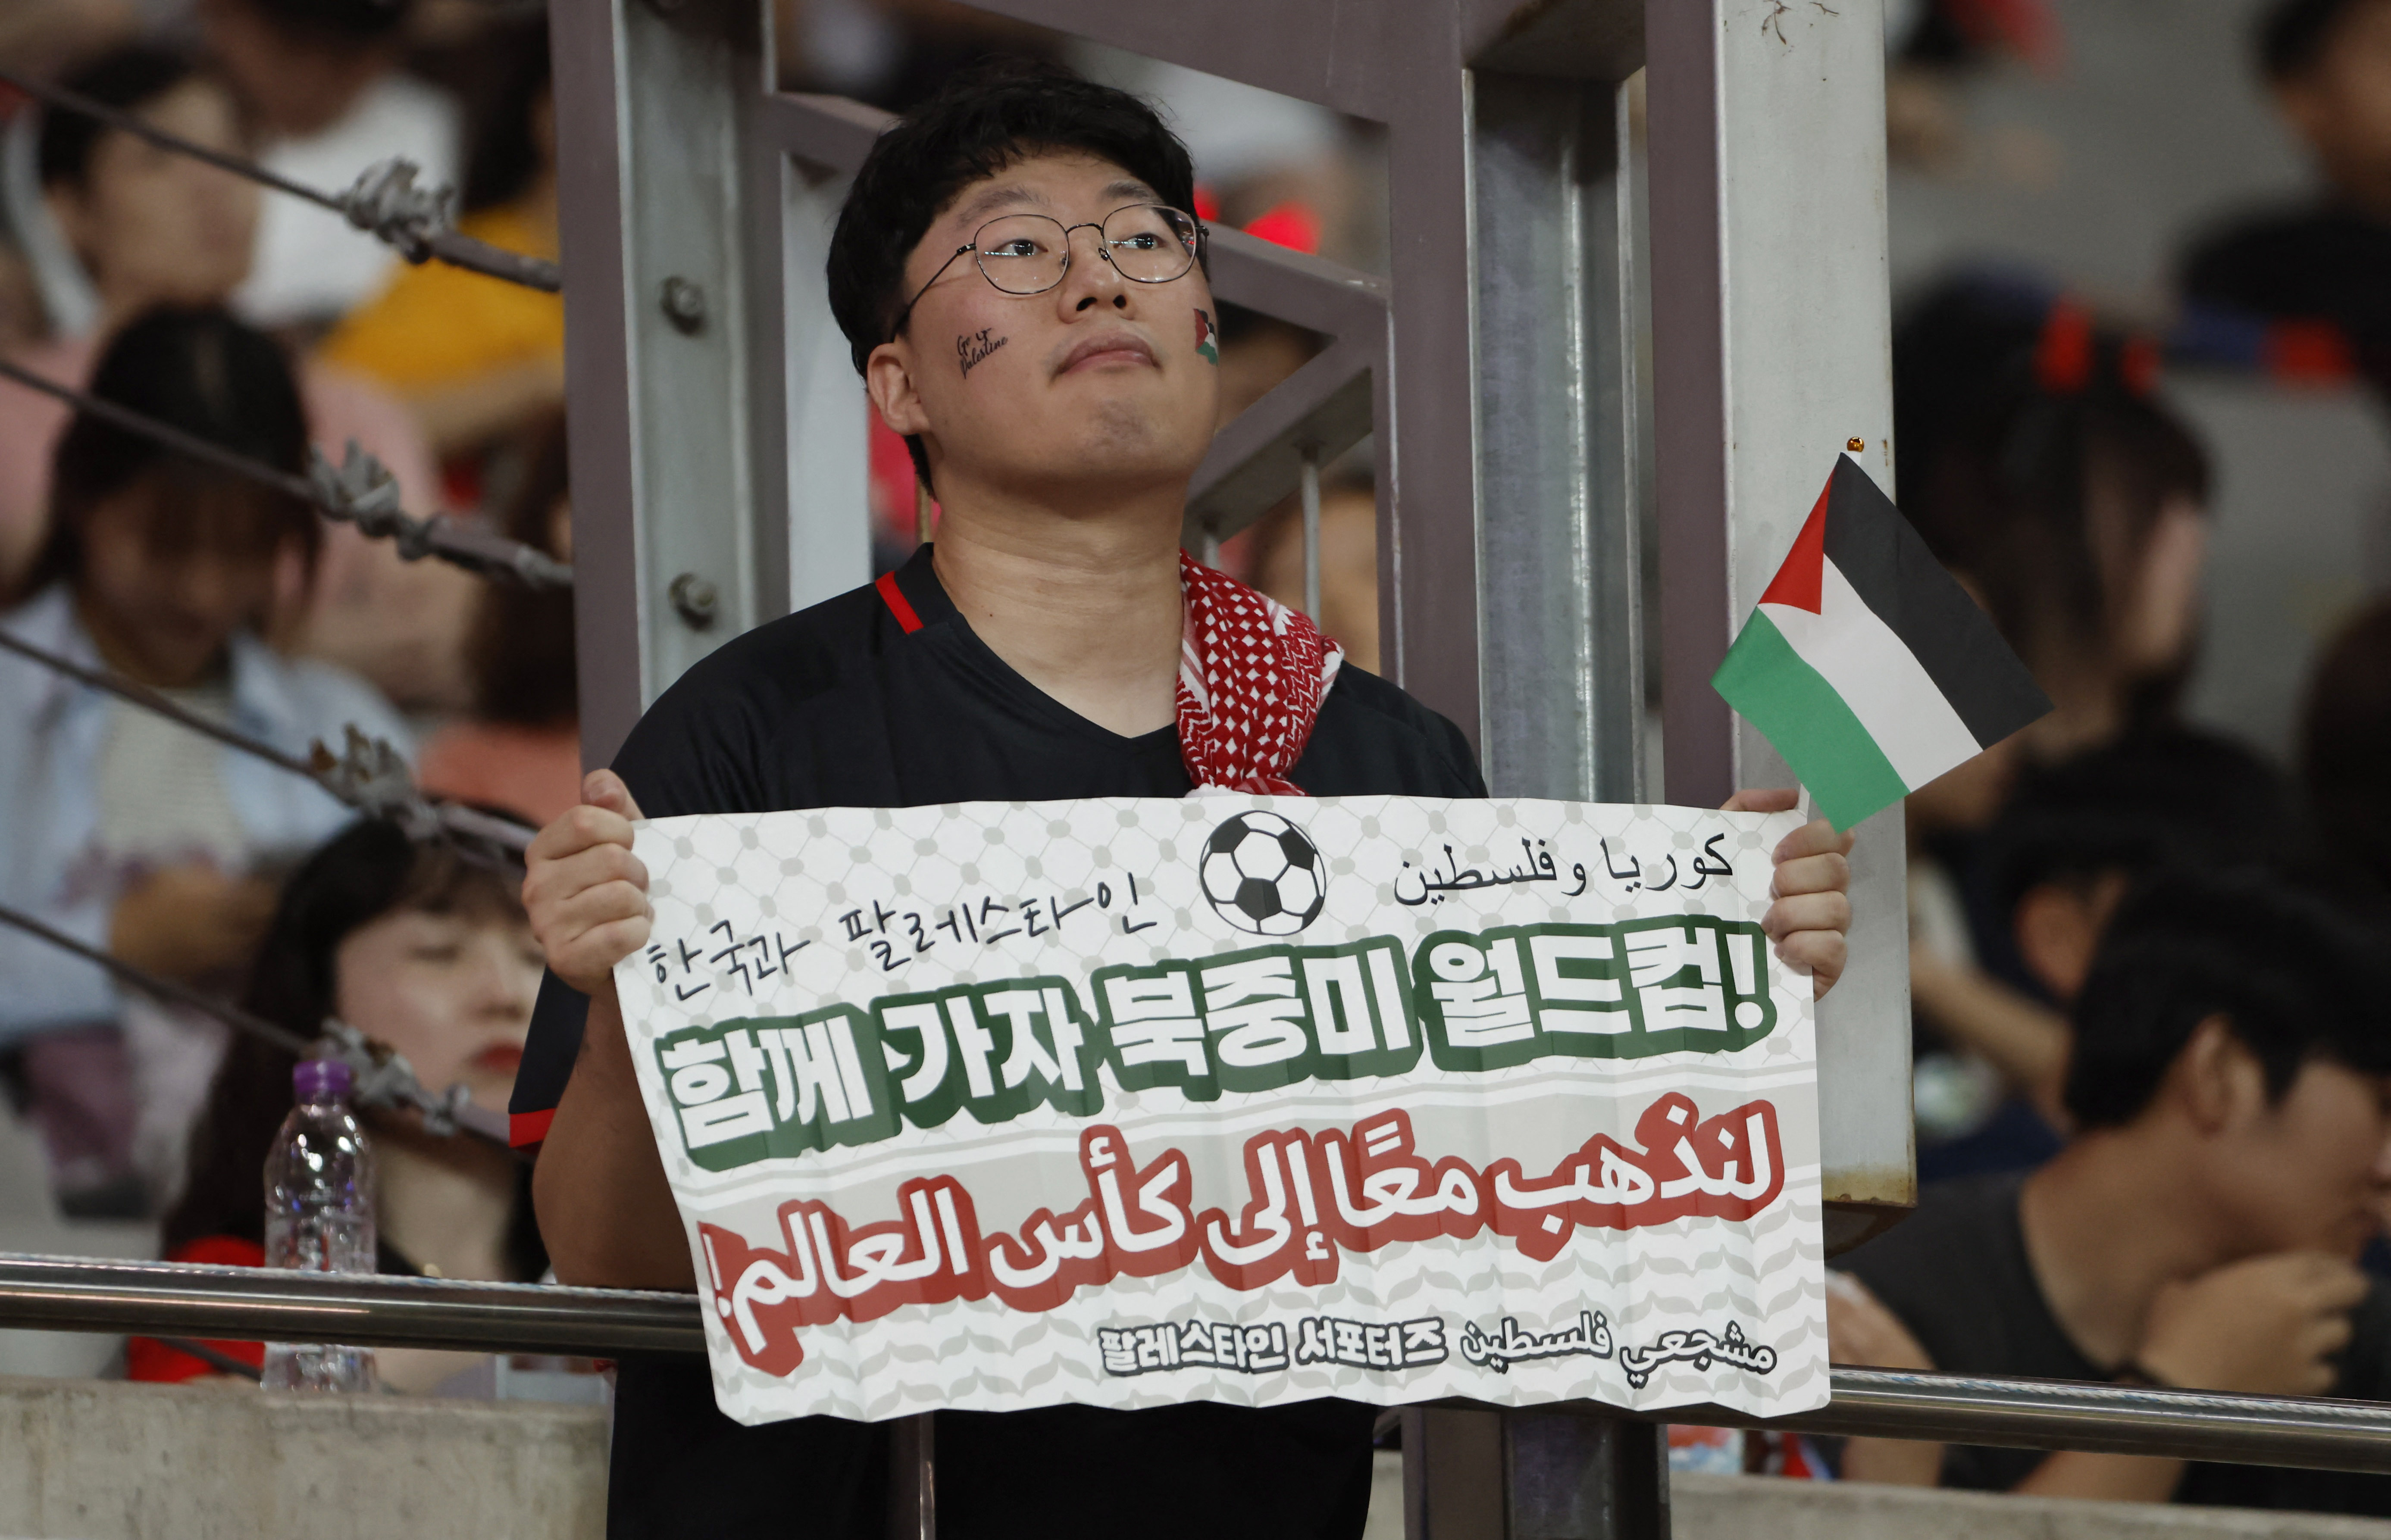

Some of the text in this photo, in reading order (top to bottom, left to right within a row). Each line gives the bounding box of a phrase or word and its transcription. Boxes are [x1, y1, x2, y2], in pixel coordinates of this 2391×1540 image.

[1599, 832, 1734, 893] كوريا
[646, 871, 1157, 1002] 한국과 팔레스타인
[660, 924, 1767, 1152] 함께 가자 북중미 월드컵!
[986, 1133, 1189, 1291] كأس
[1204, 1138, 1329, 1267] إلى
[1493, 1101, 1774, 1237] لنذهب
[698, 1184, 973, 1358] العالم!
[1097, 1316, 1449, 1377] 팔레스타인 서포터즈
[1460, 1310, 1778, 1390] مشجعي فلسطين
